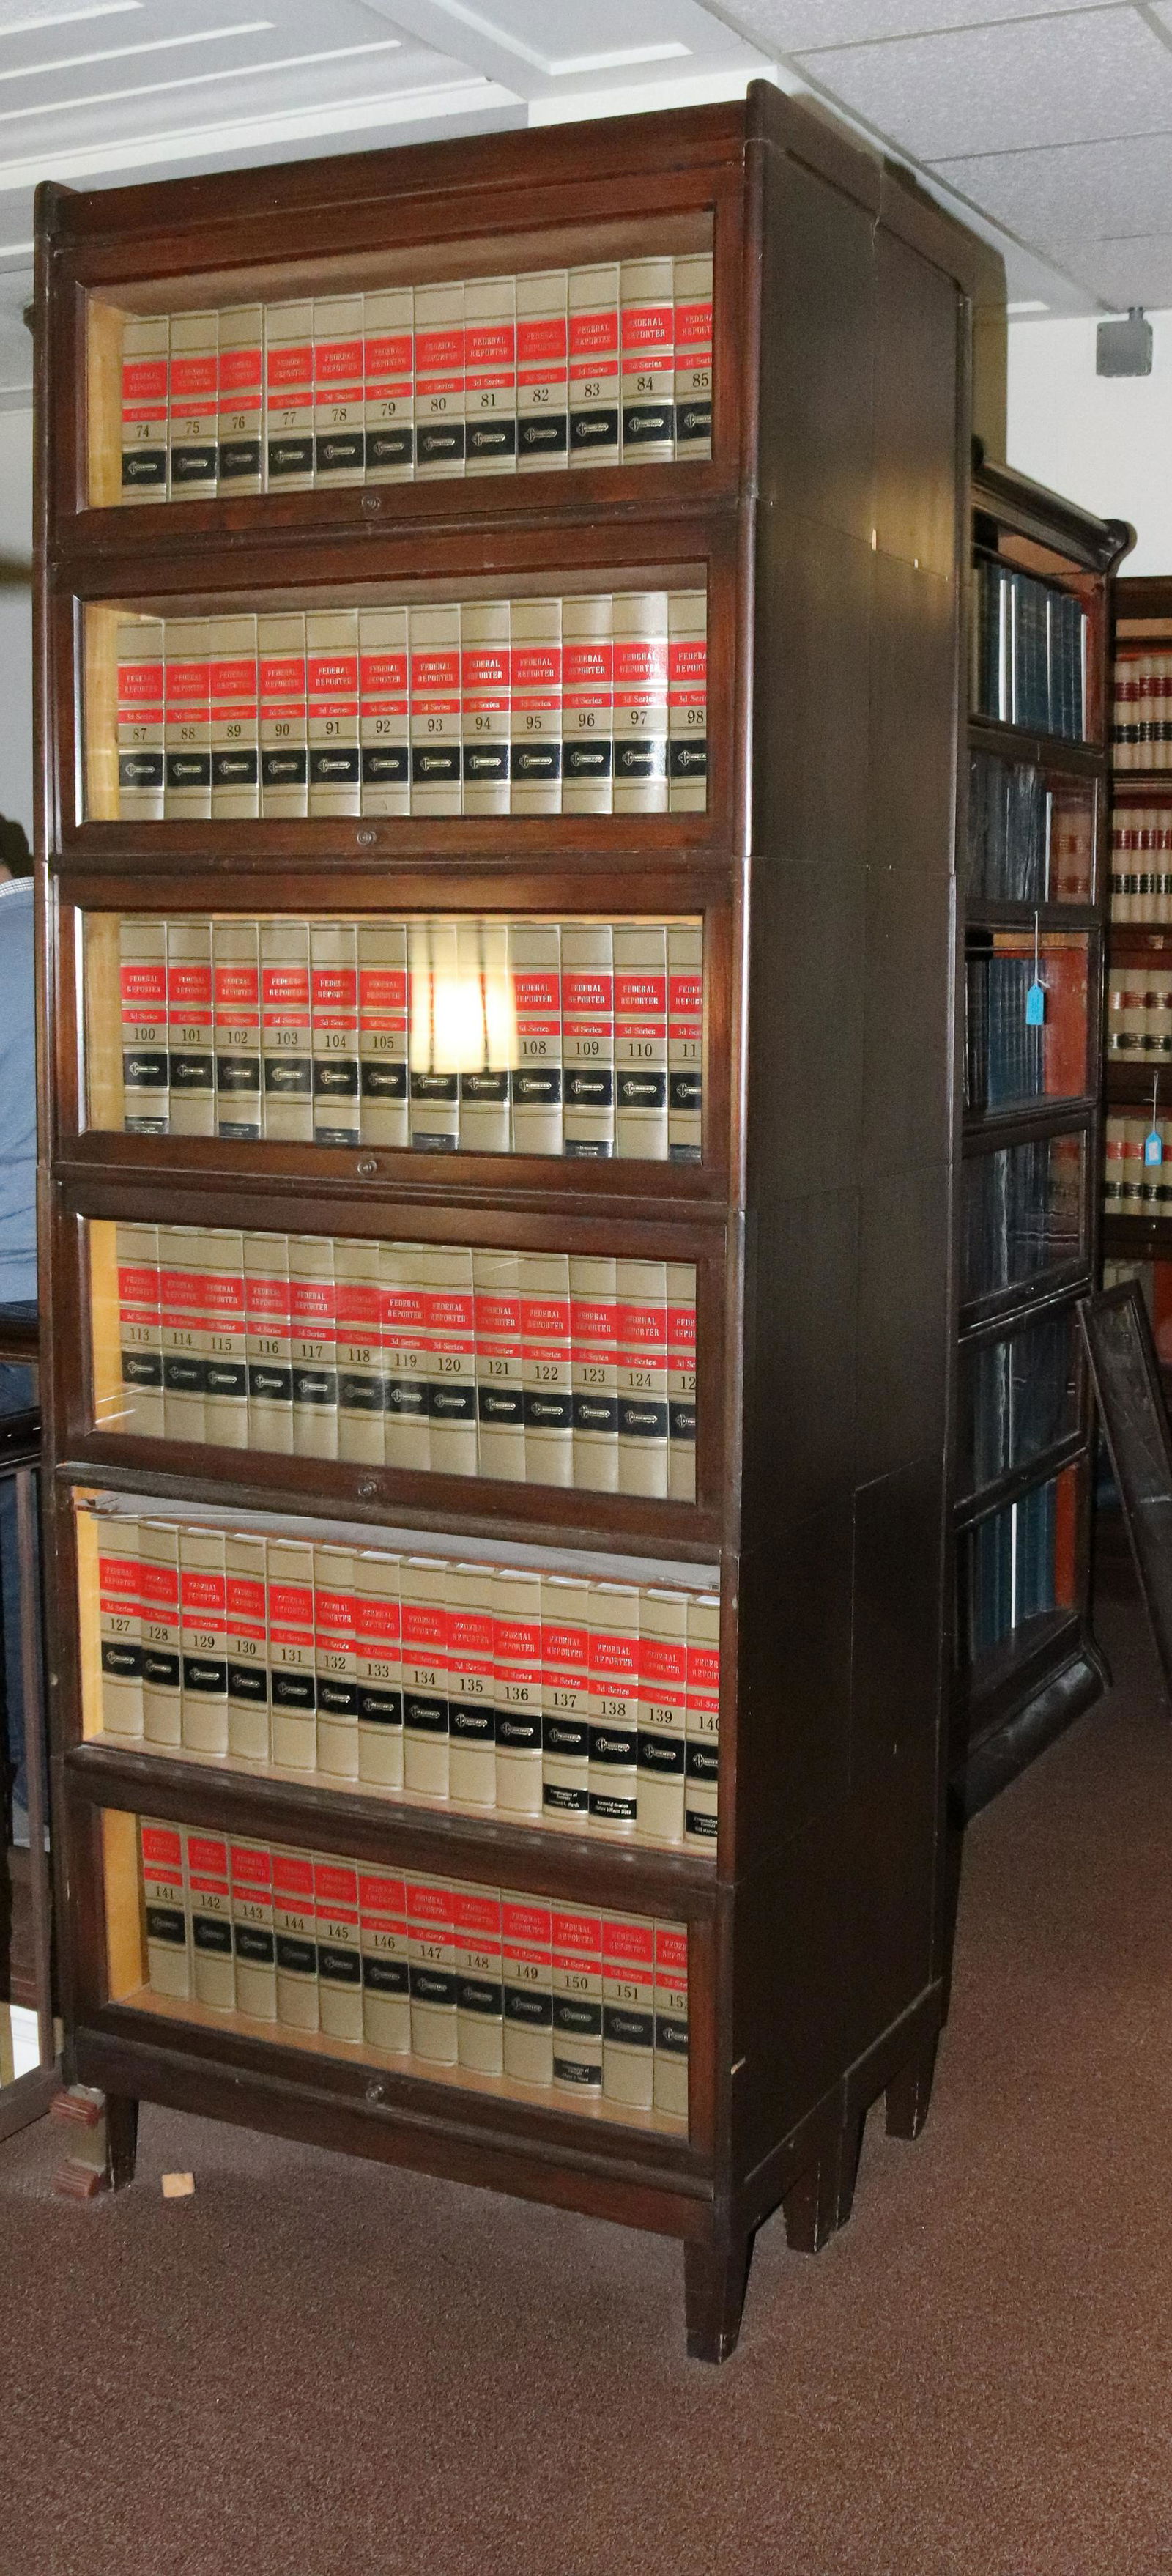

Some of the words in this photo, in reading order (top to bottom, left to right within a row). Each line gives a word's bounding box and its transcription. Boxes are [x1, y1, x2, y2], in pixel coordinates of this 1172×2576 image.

[472, 336, 505, 346] FEDERAL
[470, 347, 508, 358] REPORTER
[639, 360, 662, 368] Series
[637, 377, 653, 391] 84
[692, 374, 708, 387] 85
[533, 389, 549, 401] 82
[585, 383, 600, 396] 83
[431, 399, 446, 411] 80
[481, 394, 495, 407] 81
[332, 408, 346, 421] 78
[381, 403, 396, 415] 79
[232, 416, 245, 429] 76
[282, 412, 297, 424] 77
[136, 425, 149, 437] 74
[185, 421, 199, 434] 75
[526, 716, 541, 729] 95
[579, 714, 595, 727] 96
[631, 711, 647, 724] 97
[687, 710, 703, 723] 98
[275, 724, 289, 736] 90
[326, 722, 340, 734] 91
[376, 720, 390, 732] 92
[428, 719, 442, 731] 93
[475, 717, 490, 730] 94
[133, 728, 146, 740] 87
[181, 727, 195, 739] 88
[227, 725, 241, 736] 89
[623, 985, 656, 993] FEDERAL
[620, 996, 659, 1005] REPORTER
[134, 1028, 155, 1040] 100
[182, 1029, 201, 1041] 101
[581, 1026, 602, 1034] Series
[228, 1032, 248, 1044] 102
[277, 1032, 298, 1044] 103
[325, 1035, 346, 1047] 104
[373, 1036, 394, 1049] 105
[522, 1041, 546, 1054] 108
[575, 1042, 598, 1055] 109
[629, 1044, 652, 1056] 110
[390, 1298, 420, 1308] FEDERAL
[387, 1309, 422, 1320] REPORTER
[130, 1328, 149, 1341] 113
[173, 1333, 192, 1345] 114
[211, 1337, 231, 1350] 115
[258, 1340, 278, 1353] 116
[401, 1339, 420, 1347] Series
[444, 1343, 464, 1351] Series
[302, 1344, 322, 1358] 117
[349, 1348, 369, 1362] 118
[396, 1354, 417, 1366] 119
[438, 1358, 461, 1372] 120
[635, 1358, 656, 1366] Series
[489, 1362, 509, 1374] 121
[535, 1366, 558, 1380] 122
[582, 1369, 605, 1383] 123
[628, 1373, 651, 1386] 124
[111, 1618, 130, 1631] 127
[149, 1626, 168, 1640] 128
[193, 1635, 214, 1648] 129
[236, 1640, 256, 1654] 130
[281, 1648, 302, 1662] 131
[324, 1655, 346, 1669] 132
[367, 1664, 389, 1678] 133
[413, 1670, 435, 1685] 134
[460, 1679, 483, 1692] 135
[505, 1687, 529, 1700] 136
[553, 1692, 576, 1707] 137
[601, 1701, 626, 1716] 138
[649, 1708, 672, 1723] 139
[156, 1886, 174, 1900] 141
[201, 1895, 220, 1909] 142
[242, 1905, 262, 1919] 143
[285, 1915, 304, 1930] 144
[329, 1925, 349, 1939] 145
[374, 1935, 396, 1949] 146
[420, 1945, 442, 1958] 147
[467, 1955, 489, 1969] 148
[516, 1965, 538, 1979] 149
[565, 1975, 587, 1989] 150
[617, 1985, 638, 1999] 151
[669, 1994, 688, 2008] 15
